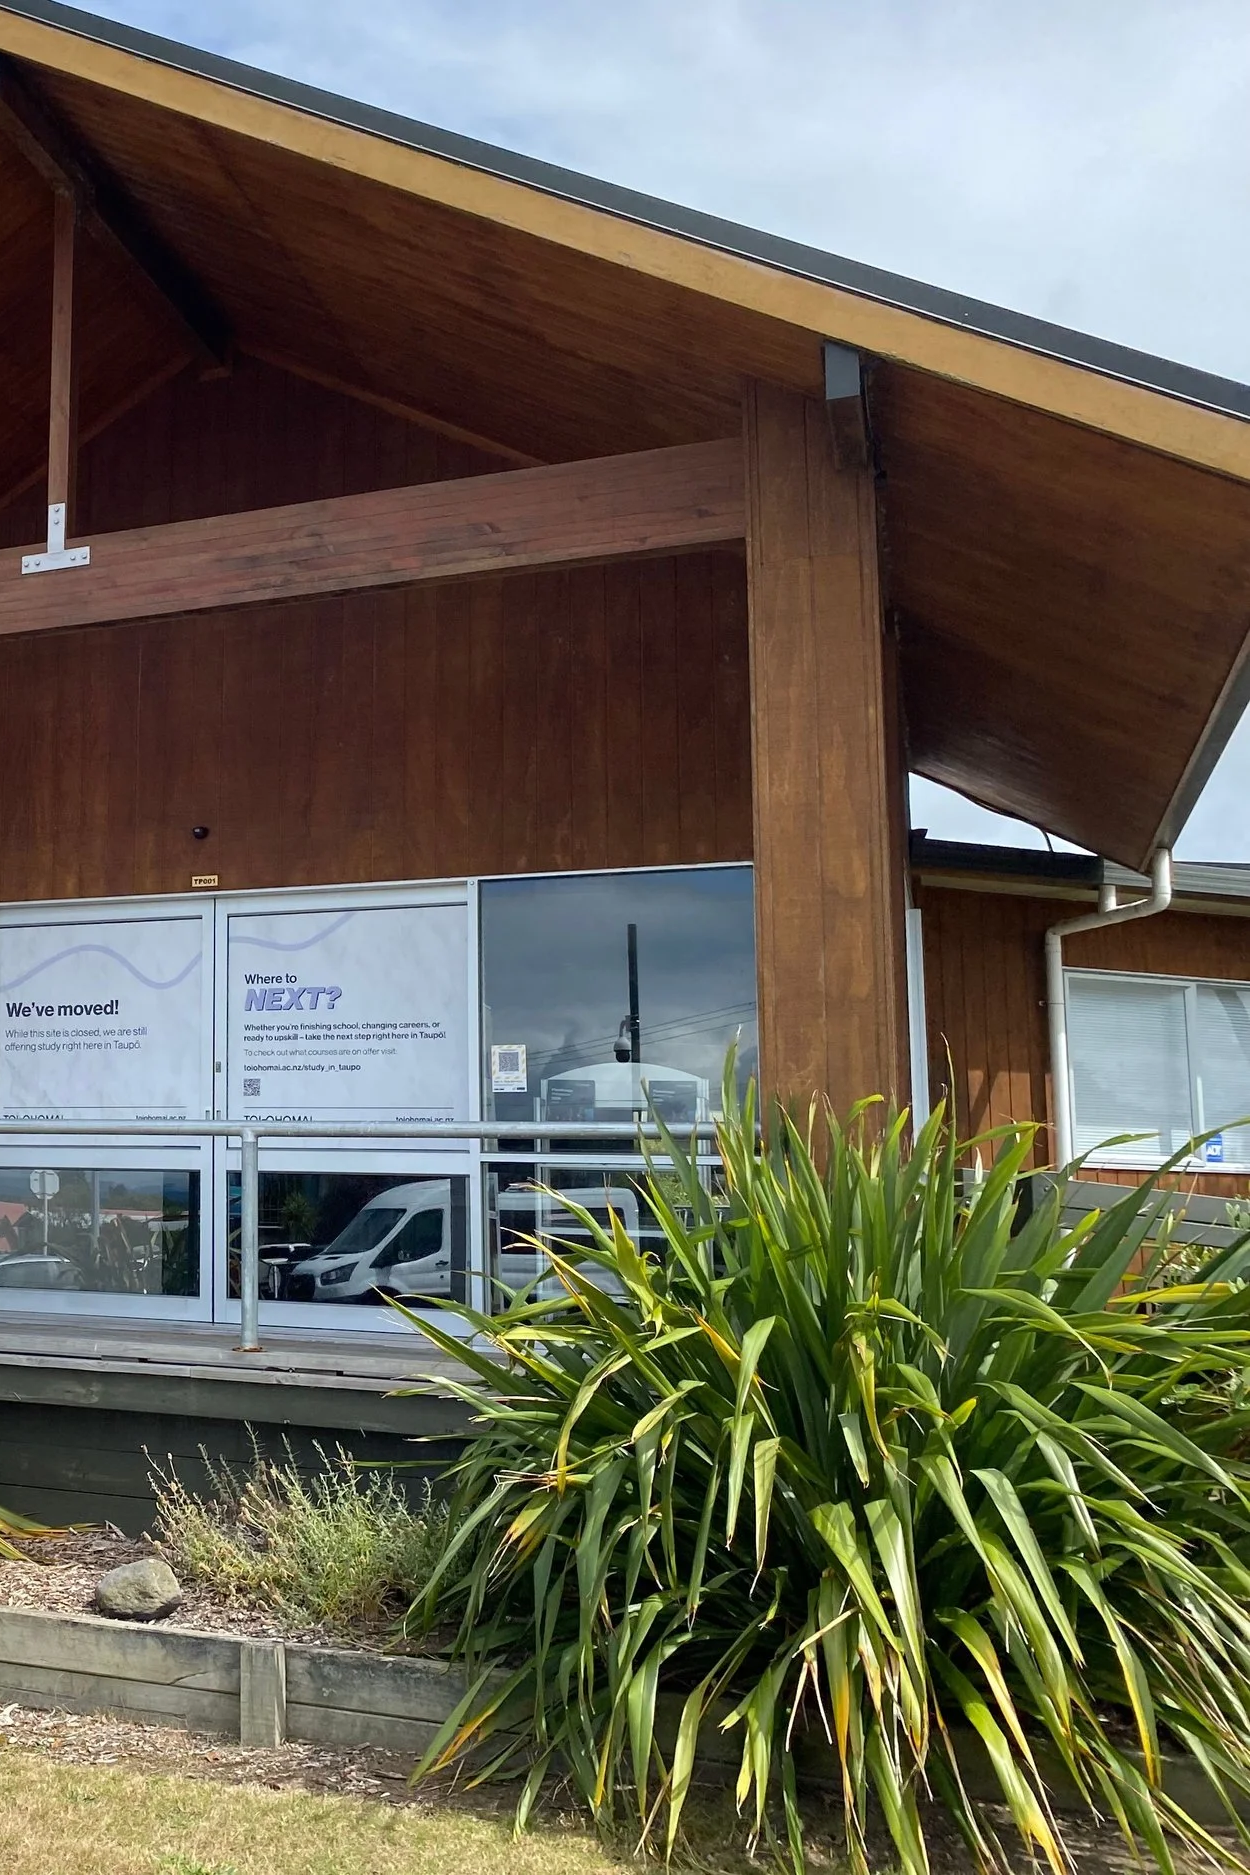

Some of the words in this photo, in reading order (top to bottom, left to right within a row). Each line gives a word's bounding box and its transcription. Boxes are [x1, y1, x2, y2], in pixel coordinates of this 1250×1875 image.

[244, 973, 282, 984] Where
[286, 973, 297, 984] to
[244, 986, 342, 1011] NEXT?
[6, 1002, 54, 1017] We've
[58, 1000, 119, 1017] moved!
[5, 1029, 29, 1038] While
[30, 1029, 44, 1038] this
[46, 1028, 61, 1038] site
[62, 1029, 70, 1037] is
[71, 1028, 101, 1037] closed,
[117, 1028, 131, 1036] are
[133, 1027, 147, 1036] still
[244, 1023, 275, 1031] Whether
[277, 1024, 299, 1032] you're
[300, 1022, 331, 1032] finishing
[333, 1022, 360, 1030] school,
[361, 1022, 397, 1030] changing
[244, 1034, 264, 1042] ready
[274, 1033, 299, 1042] upskill
[305, 1033, 321, 1041] take
[354, 1033, 371, 1041] step
[372, 1032, 390, 1040] right
[5, 1042, 36, 1052] offering
[38, 1041, 61, 1052] study
[62, 1041, 81, 1051] right
[83, 1041, 102, 1050] here
[104, 1040, 111, 1049] in
[254, 1048, 275, 1056] check
